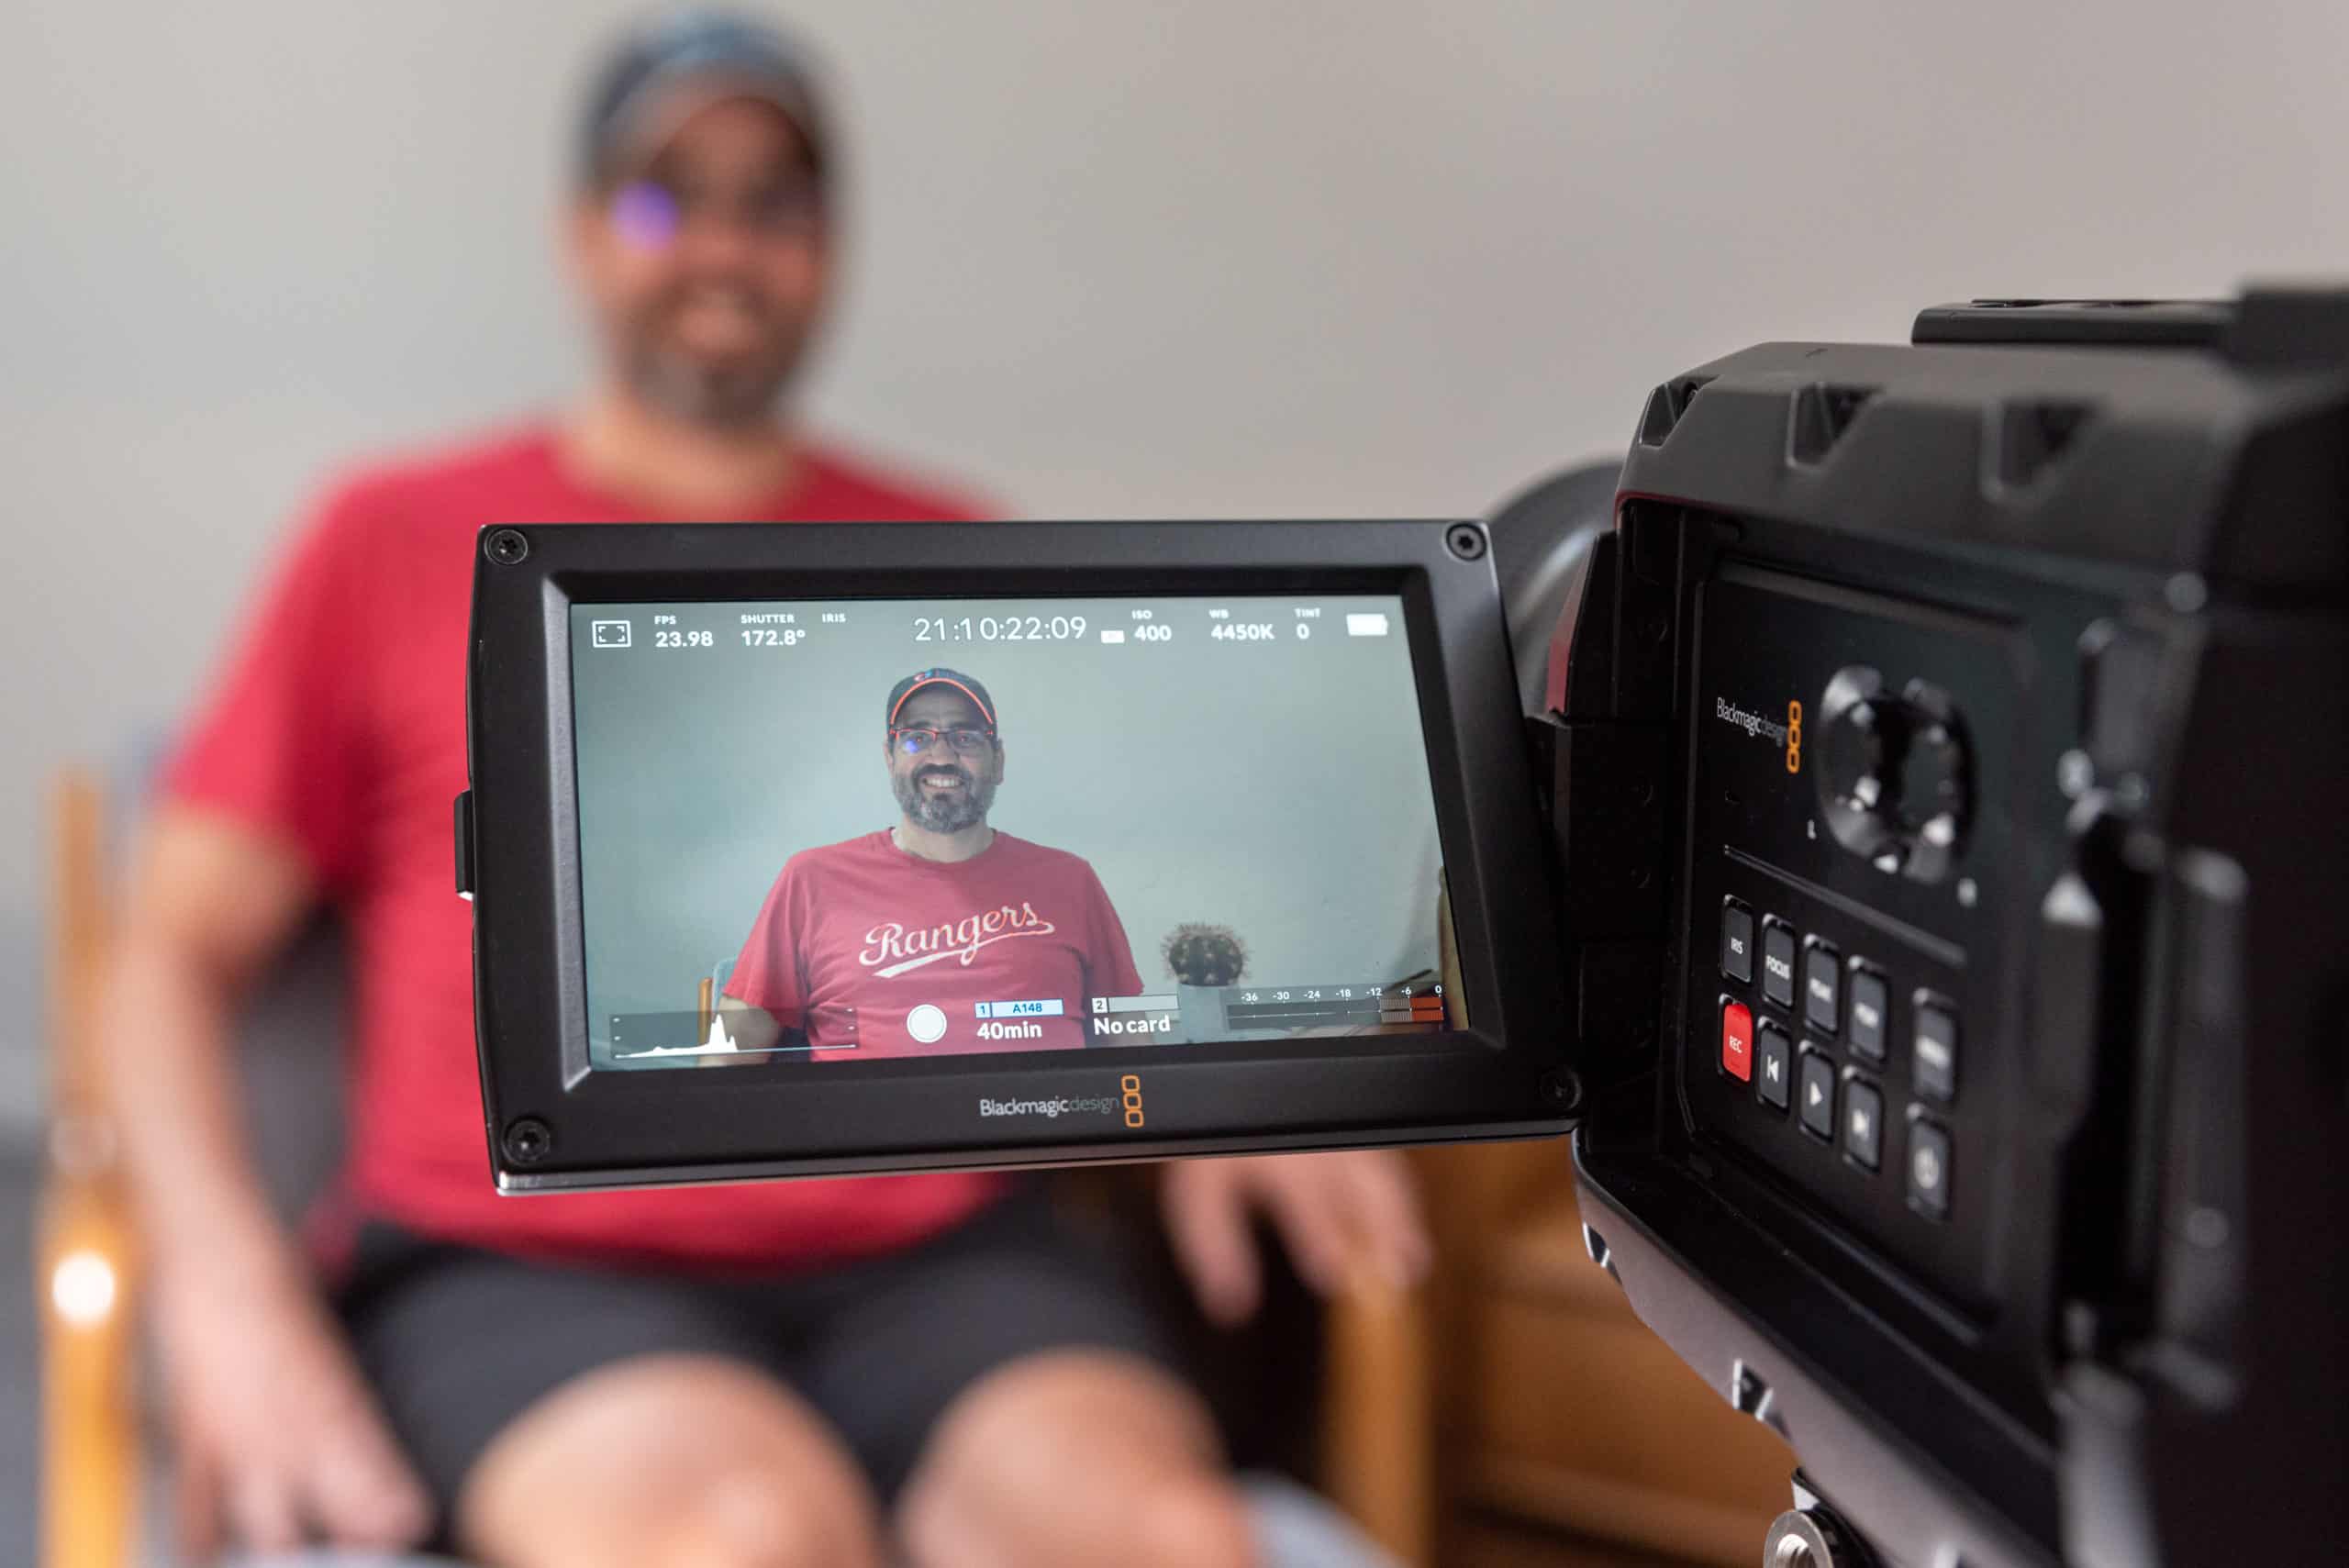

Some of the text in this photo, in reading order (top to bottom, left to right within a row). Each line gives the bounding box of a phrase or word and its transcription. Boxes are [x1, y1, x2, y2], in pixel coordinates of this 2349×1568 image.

[654, 615, 676, 625] FPS
[740, 614, 795, 625] SHUTTER
[822, 613, 846, 623] IRIS
[1131, 609, 1152, 619] ISO
[1208, 609, 1229, 619] WB
[1295, 607, 1320, 617] TINT
[914, 617, 1086, 641] 21:10:22:09
[1134, 625, 1172, 641] 400
[1210, 624, 1275, 640] 4450K
[1296, 623, 1310, 639] 0
[655, 630, 713, 648] 23.98
[741, 628, 806, 647] 172.8°
[859, 902, 1055, 978] Rangers
[1241, 984, 1442, 1002] -36 -30 -24 -18 -12 -6 0
[980, 1005, 986, 1016] 1
[1012, 1002, 1042, 1014] A148
[1096, 999, 1104, 1011] 2
[976, 1020, 1042, 1040] 40min
[1093, 1015, 1171, 1035] No card
